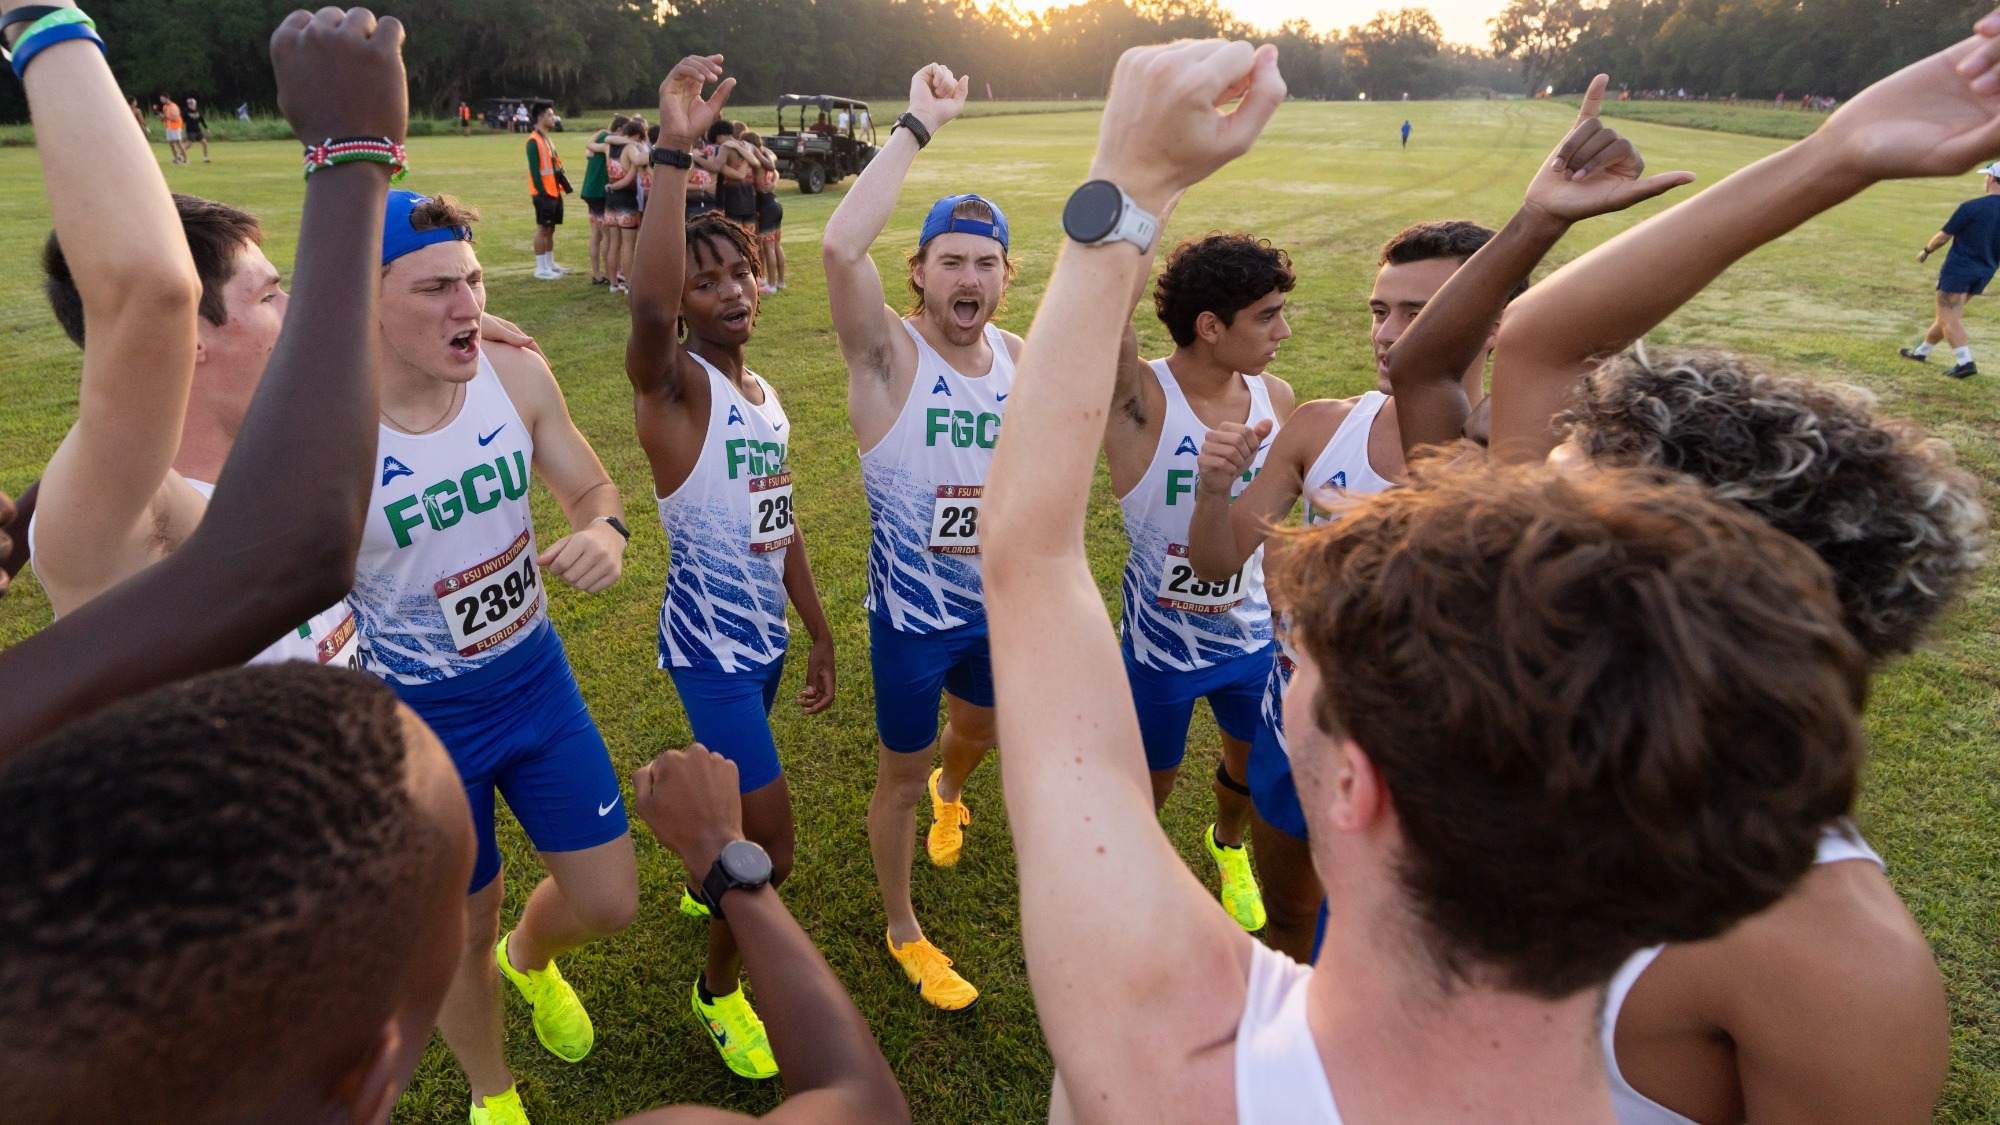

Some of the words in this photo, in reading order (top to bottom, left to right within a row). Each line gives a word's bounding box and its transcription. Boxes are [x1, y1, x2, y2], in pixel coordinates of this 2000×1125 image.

[926, 407, 1003, 448] FGC
[768, 478, 780, 488] FSU
[957, 487, 972, 497] FSU
[383, 450, 528, 549] FGCU
[939, 506, 979, 538] 23
[462, 568, 482, 584] FSU
[482, 536, 527, 575] INVITATIONAL
[764, 538, 792, 551] FLORIDA
[941, 546, 976, 555] FLORIDA
[455, 554, 536, 636] 2394
[1171, 600, 1210, 613] FLORIDA
[1213, 601, 1236, 613] STATE
[476, 622, 519, 651] FLORIDA
[520, 598, 540, 625] STATE
